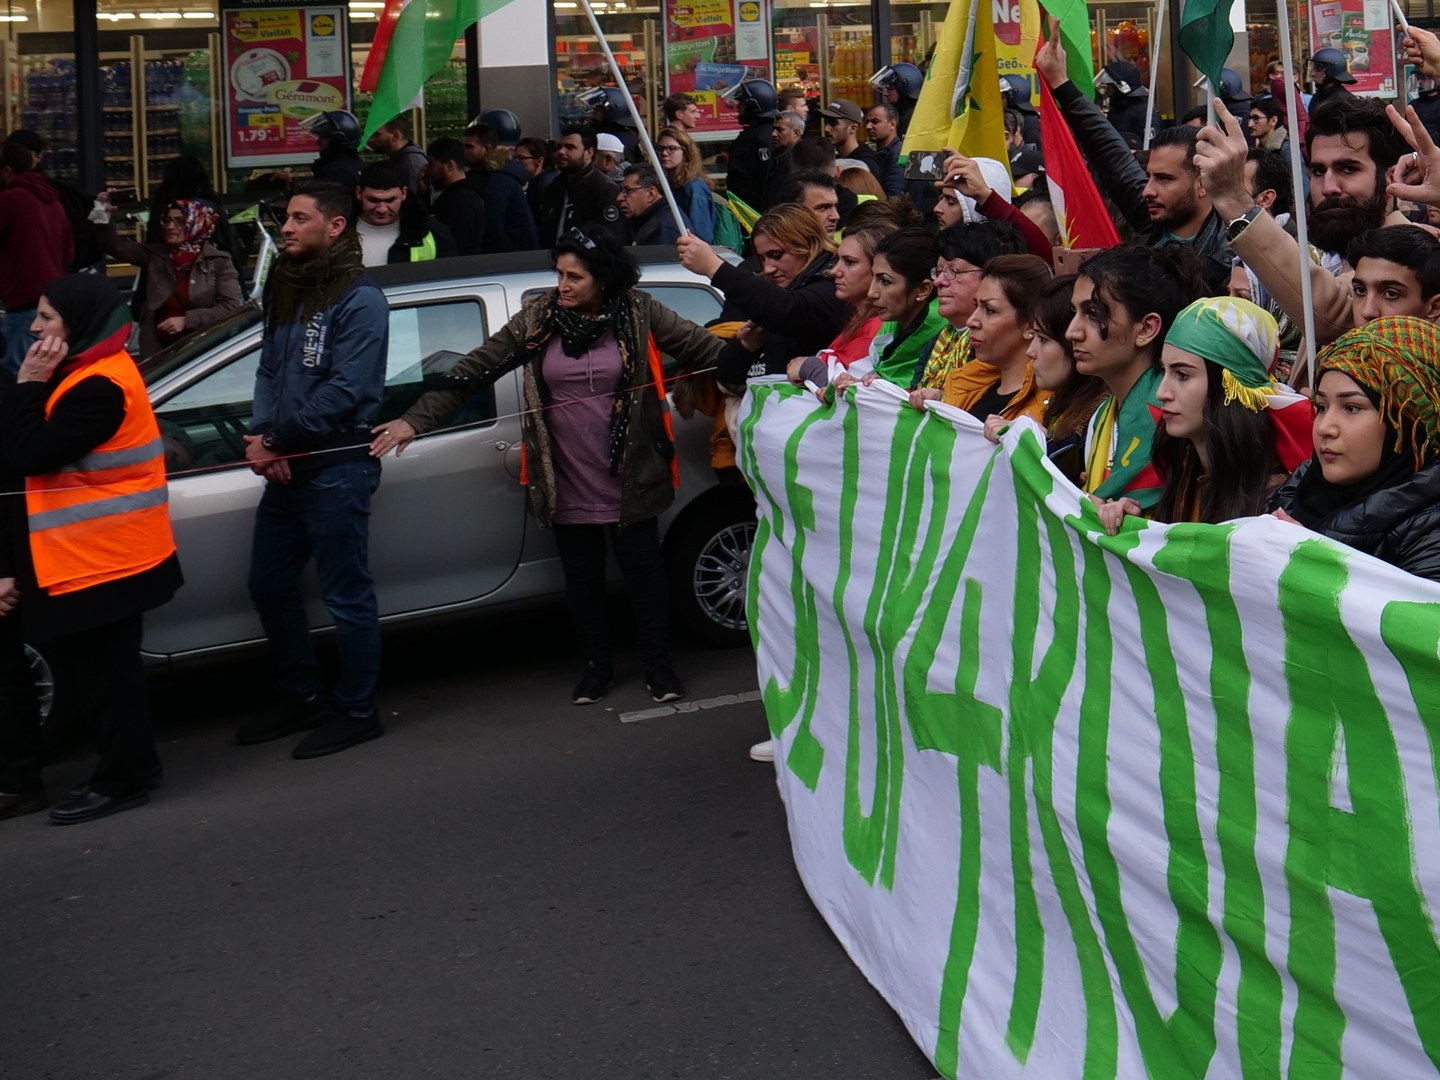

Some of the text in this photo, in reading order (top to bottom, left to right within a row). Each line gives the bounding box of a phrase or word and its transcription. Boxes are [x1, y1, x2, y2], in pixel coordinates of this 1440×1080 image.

[992, 0, 1021, 23] Ne
[694, 15, 722, 23] Vielfalt
[260, 28, 292, 37] Vielfalt
[275, 88, 337, 104] Géramont
